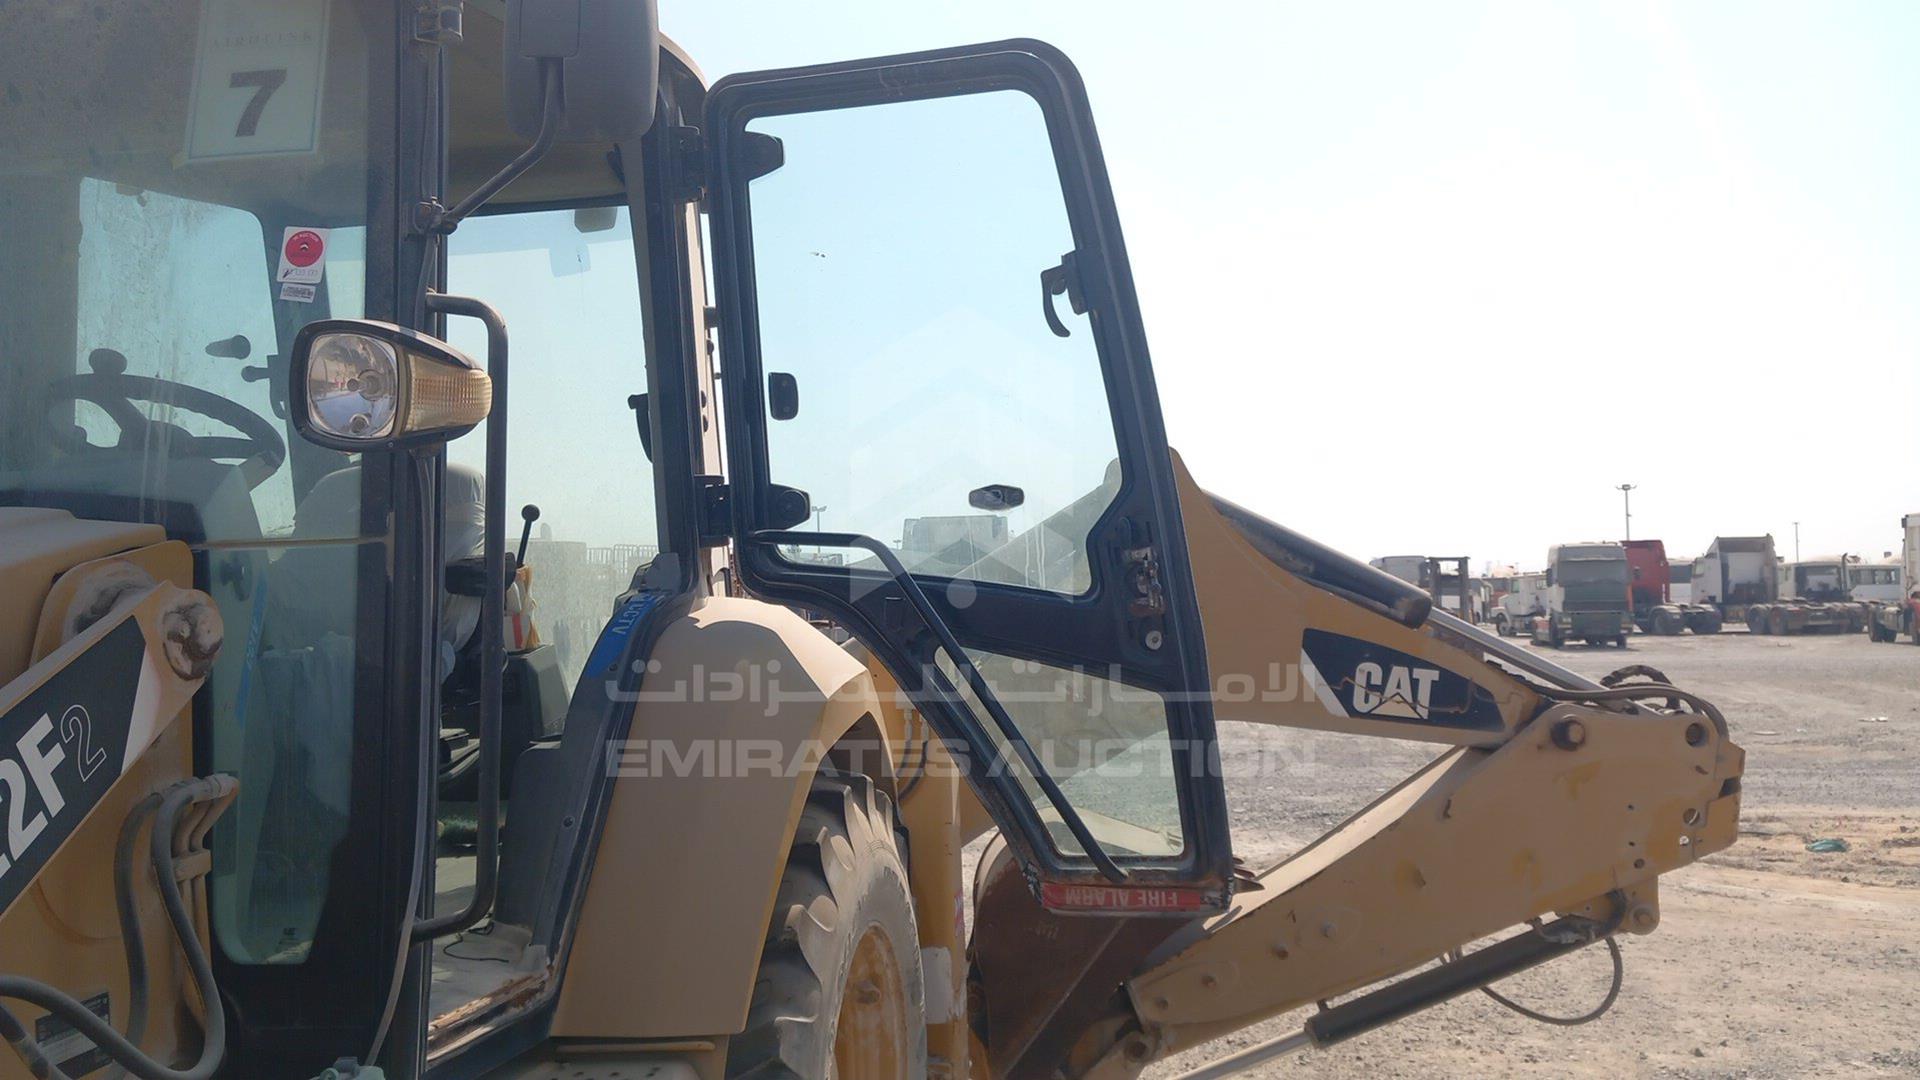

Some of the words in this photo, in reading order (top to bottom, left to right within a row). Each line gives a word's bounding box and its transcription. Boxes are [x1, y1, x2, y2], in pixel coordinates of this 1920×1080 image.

[228, 68, 288, 138] 7
[1352, 661, 1440, 720] CAT
[1065, 887, 1130, 907] ALARM
[1137, 889, 1179, 908] FIRE
